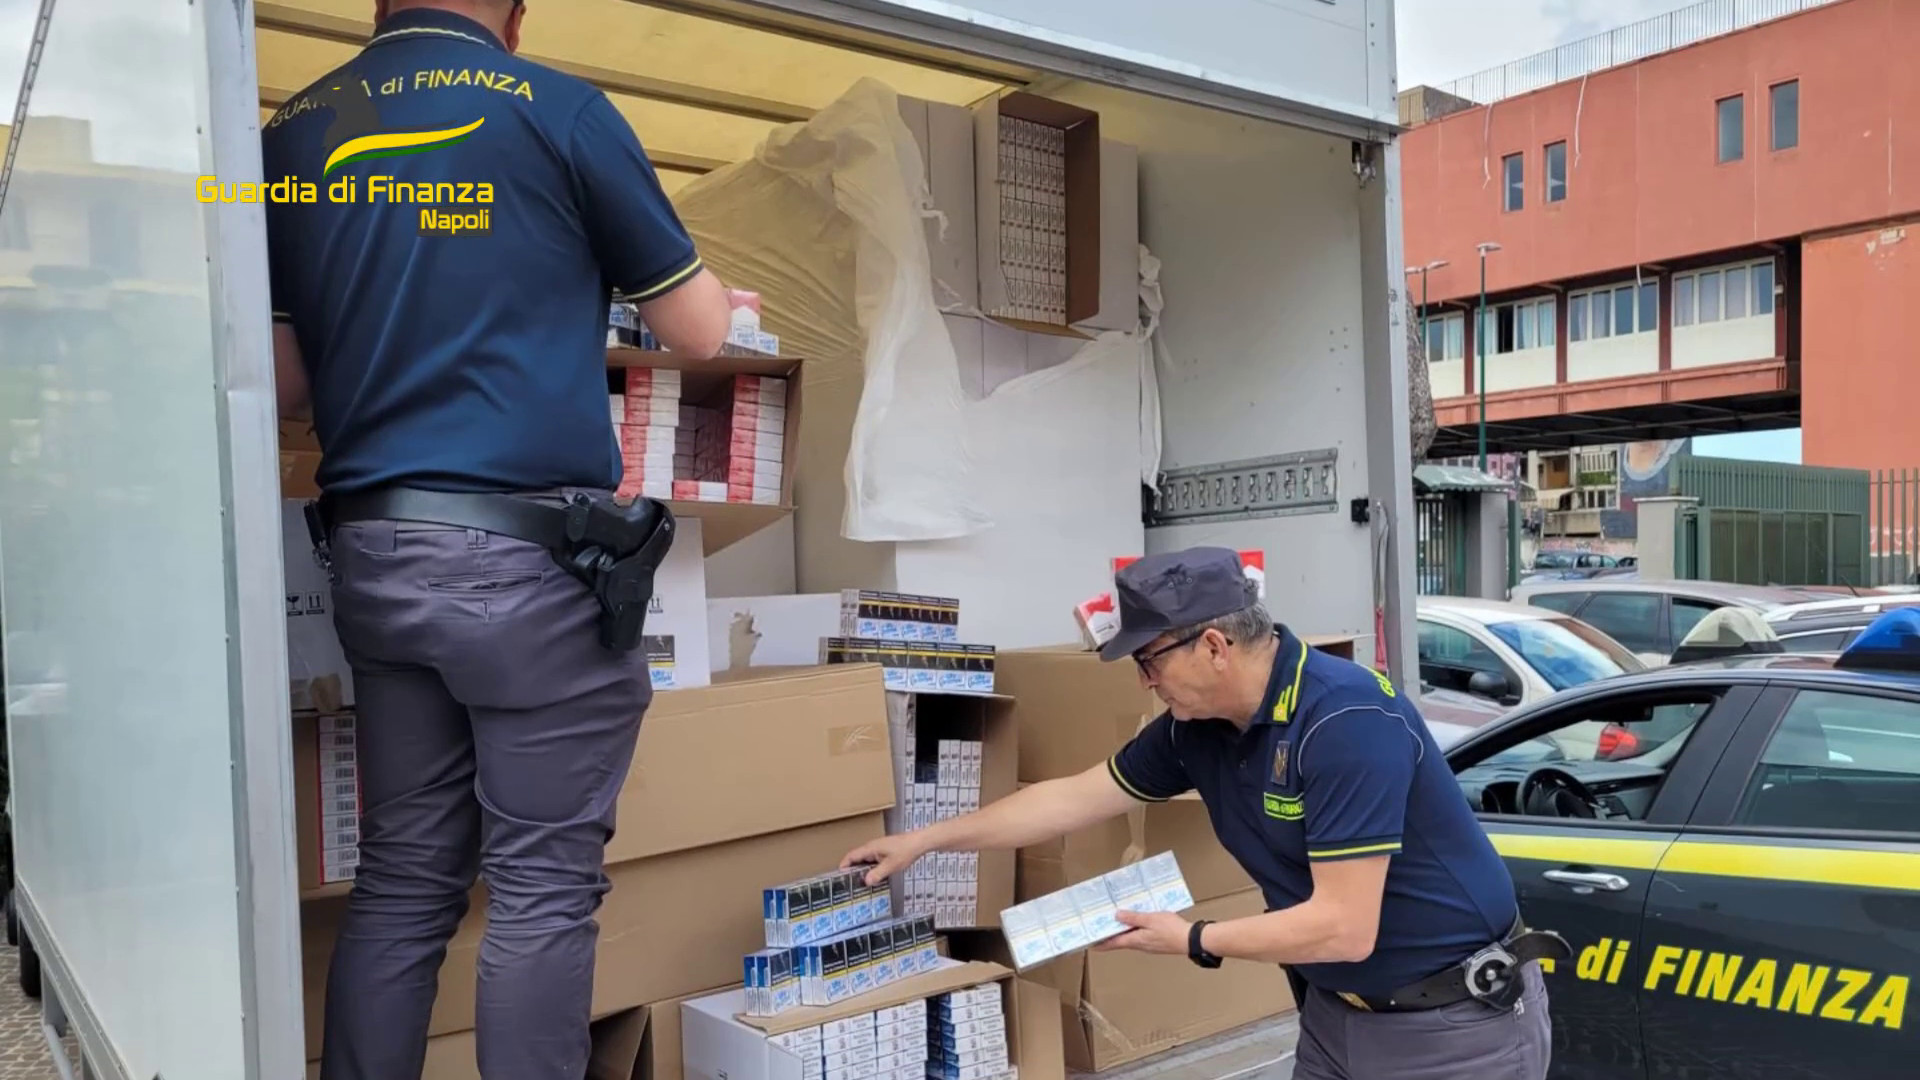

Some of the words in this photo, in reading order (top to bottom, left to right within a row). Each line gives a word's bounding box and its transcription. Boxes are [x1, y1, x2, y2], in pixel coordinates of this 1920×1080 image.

[380, 77, 403, 95] di
[414, 69, 534, 101] FINANZA
[1576, 937, 1631, 984] di
[1643, 945, 1910, 1030] FINANZA
